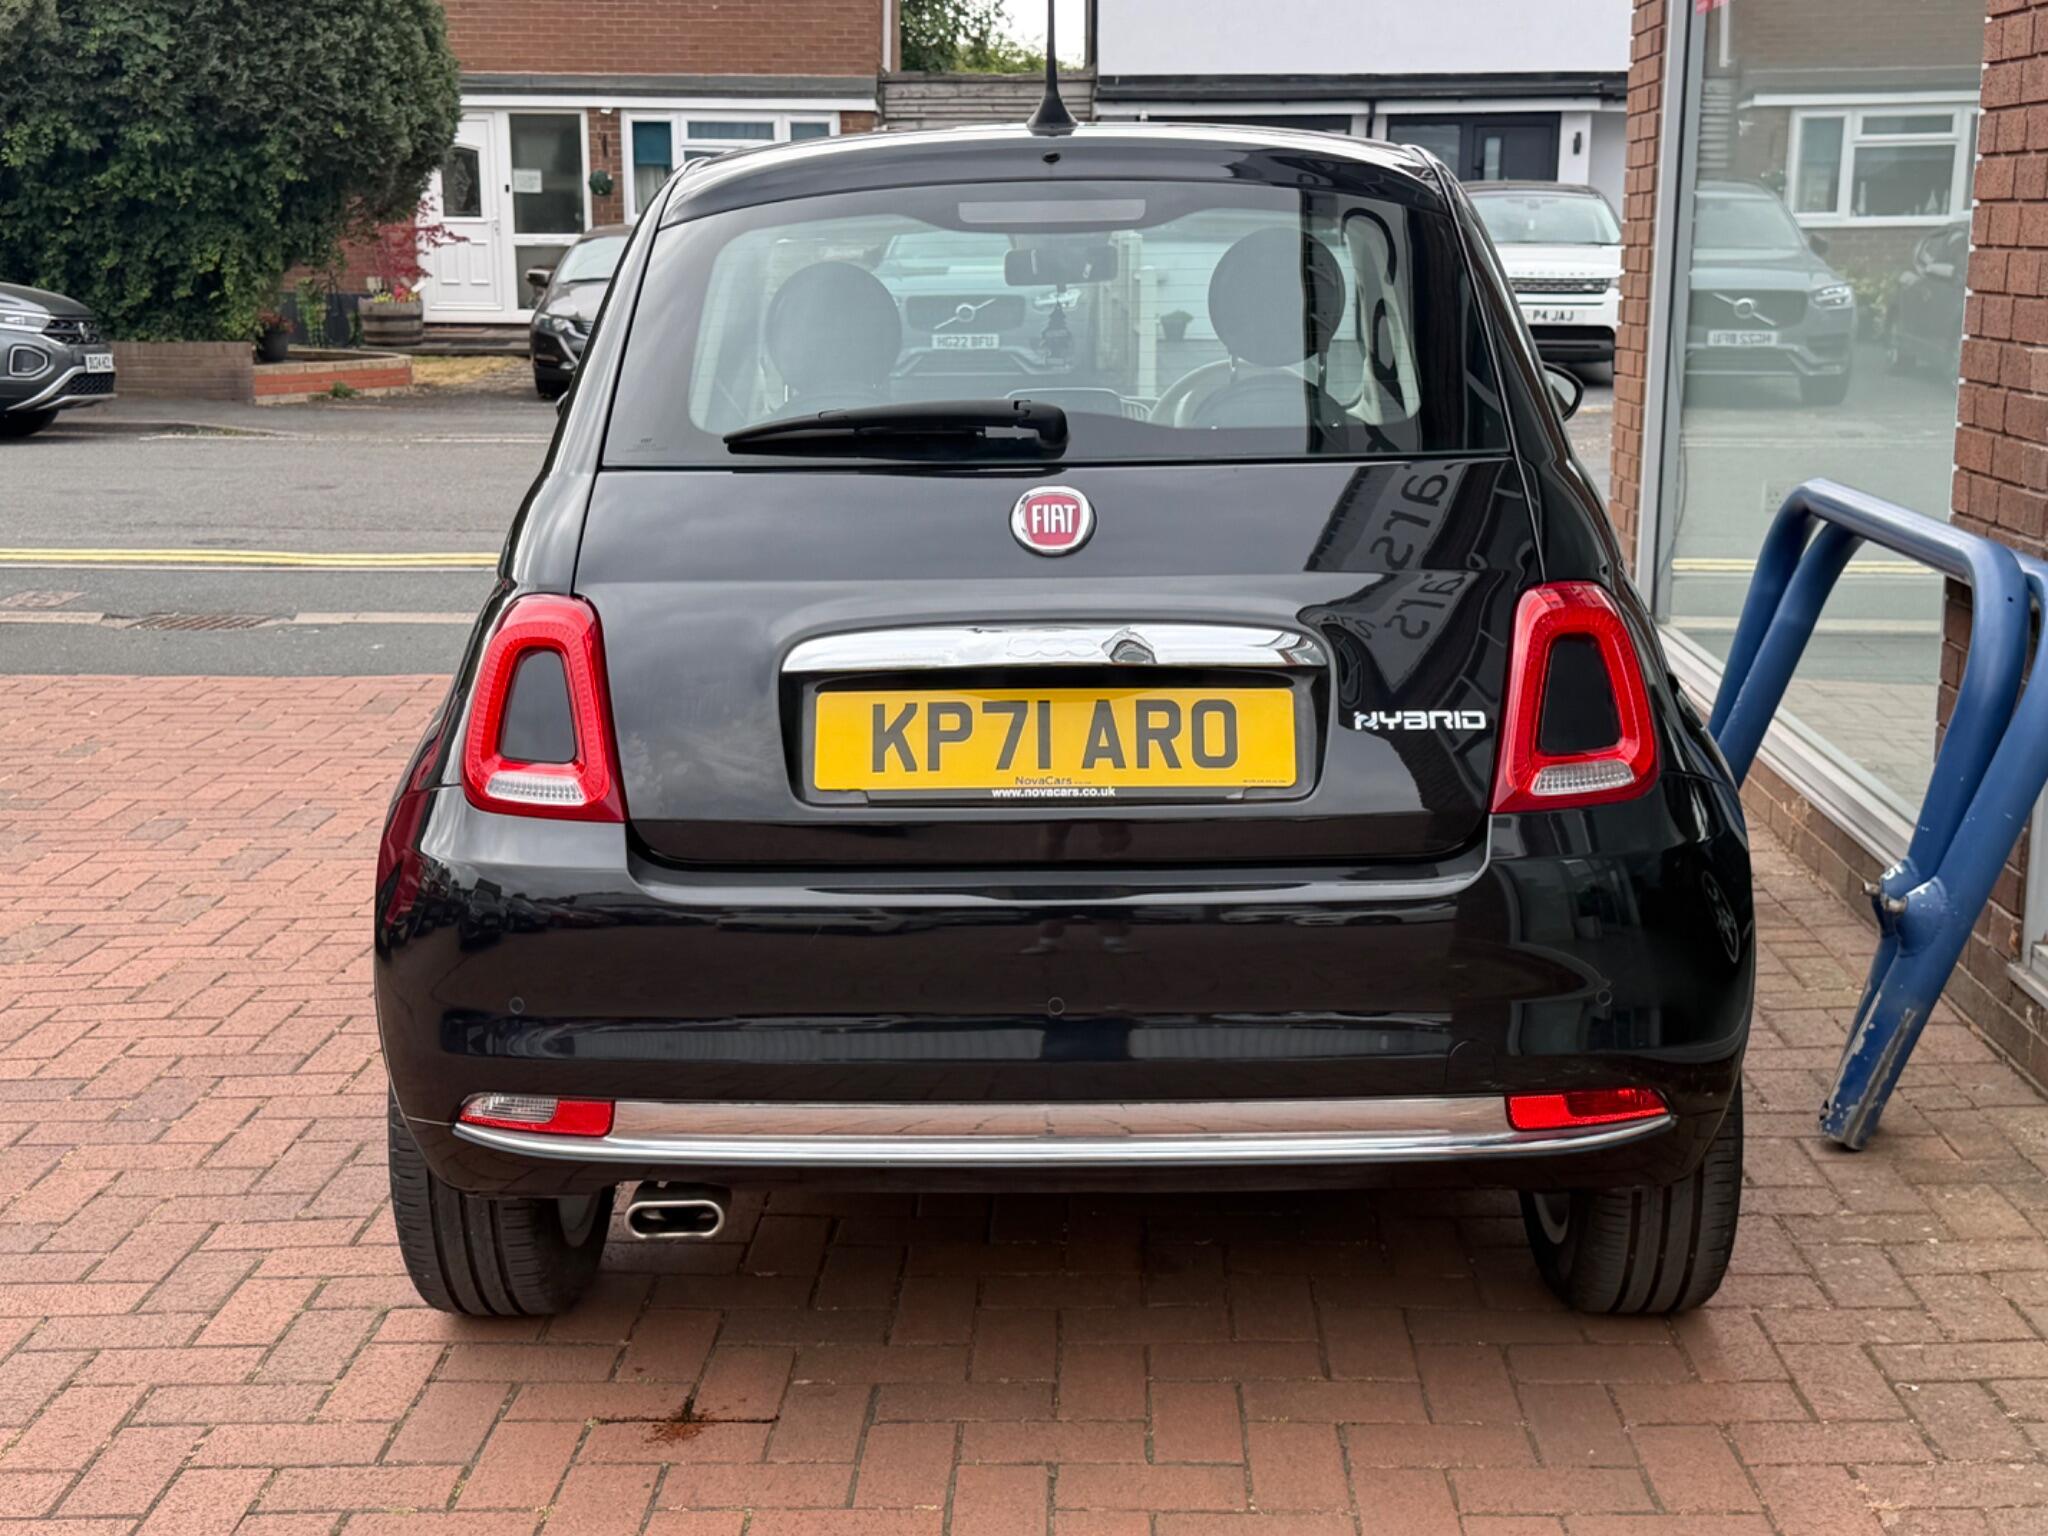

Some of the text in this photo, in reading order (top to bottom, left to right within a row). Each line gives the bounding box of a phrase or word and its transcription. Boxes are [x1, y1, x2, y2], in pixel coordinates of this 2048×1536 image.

[1533, 309, 1574, 321] P4 JAJ
[1031, 504, 1077, 535] FIAT
[1353, 710, 1487, 730] HYBRID
[871, 698, 1239, 773] KP71 ARO
[1015, 775, 1072, 786] NovaCars
[991, 786, 1117, 798] www.novacars.co.uk
